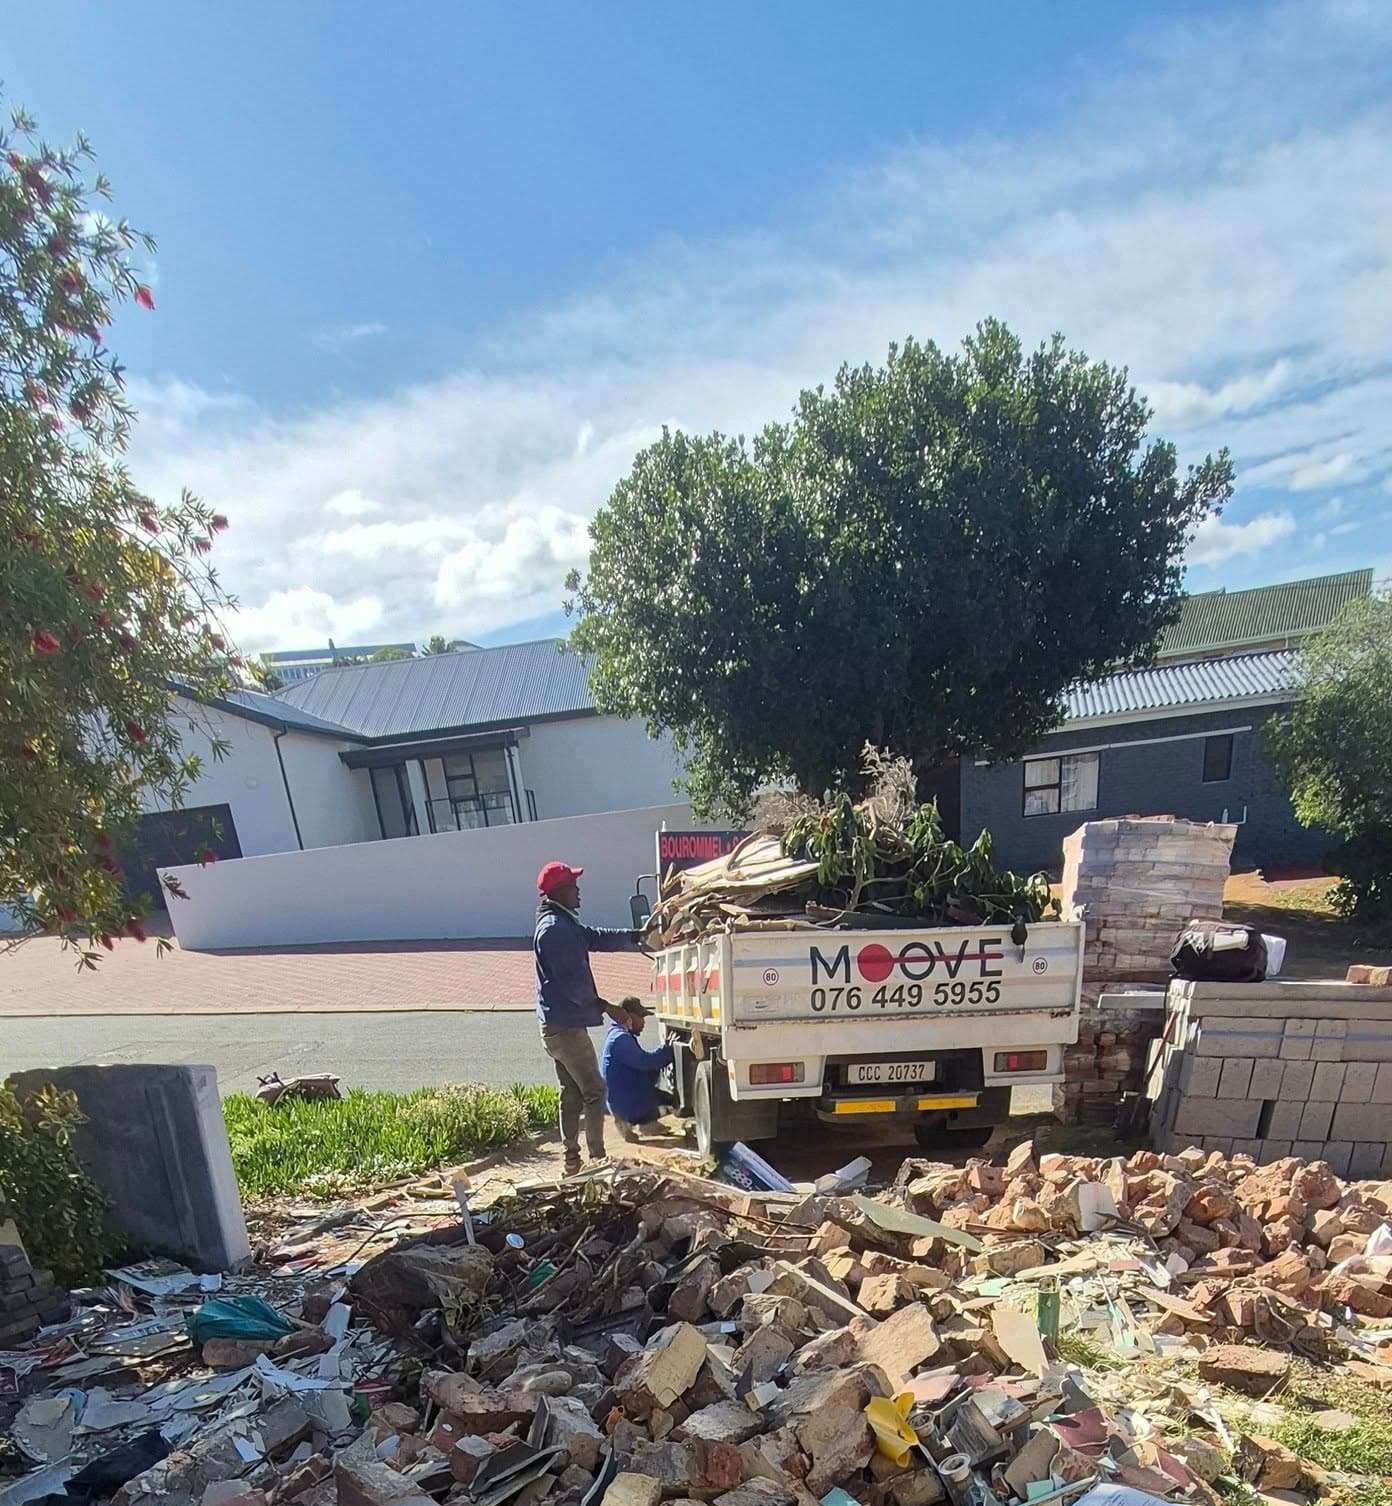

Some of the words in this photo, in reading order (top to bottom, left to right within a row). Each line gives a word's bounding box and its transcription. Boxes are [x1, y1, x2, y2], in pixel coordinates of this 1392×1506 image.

[1035, 961, 1045, 970] 80
[765, 972, 777, 982] 80
[810, 987, 862, 1011] 076
[872, 984, 923, 1008] 449
[933, 980, 1001, 1006] 5955
[858, 1065, 881, 1081] CCC
[888, 1063, 925, 1080] 20737
